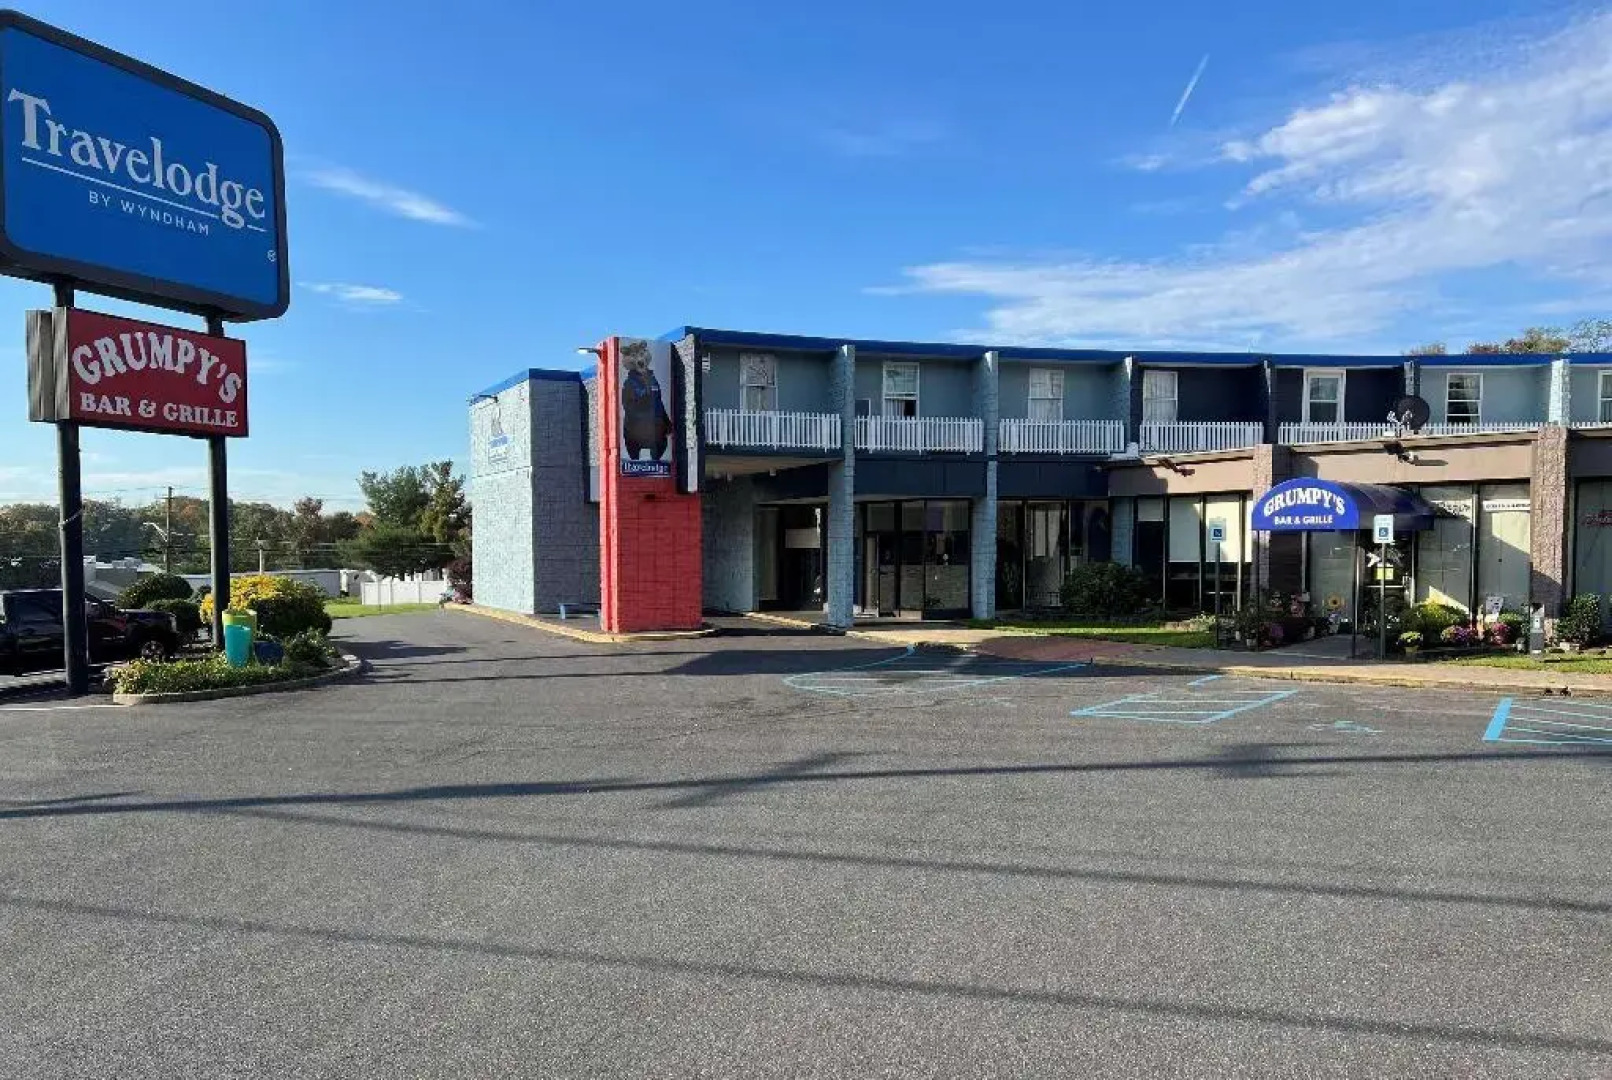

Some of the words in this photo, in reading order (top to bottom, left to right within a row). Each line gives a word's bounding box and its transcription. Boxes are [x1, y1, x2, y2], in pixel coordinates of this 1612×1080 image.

[8, 88, 266, 229] Travelodge
[89, 190, 111, 207] BY
[120, 199, 210, 236] WYNDHAM
[72, 331, 242, 403] GRUMPY'S
[80, 391, 132, 416] BAR
[138, 399, 157, 418] &
[163, 402, 239, 428] GRILLE
[1263, 487, 1346, 517] GRUMPY'S
[1274, 515, 1293, 525] BAR
[1303, 514, 1333, 525] GRILLE
